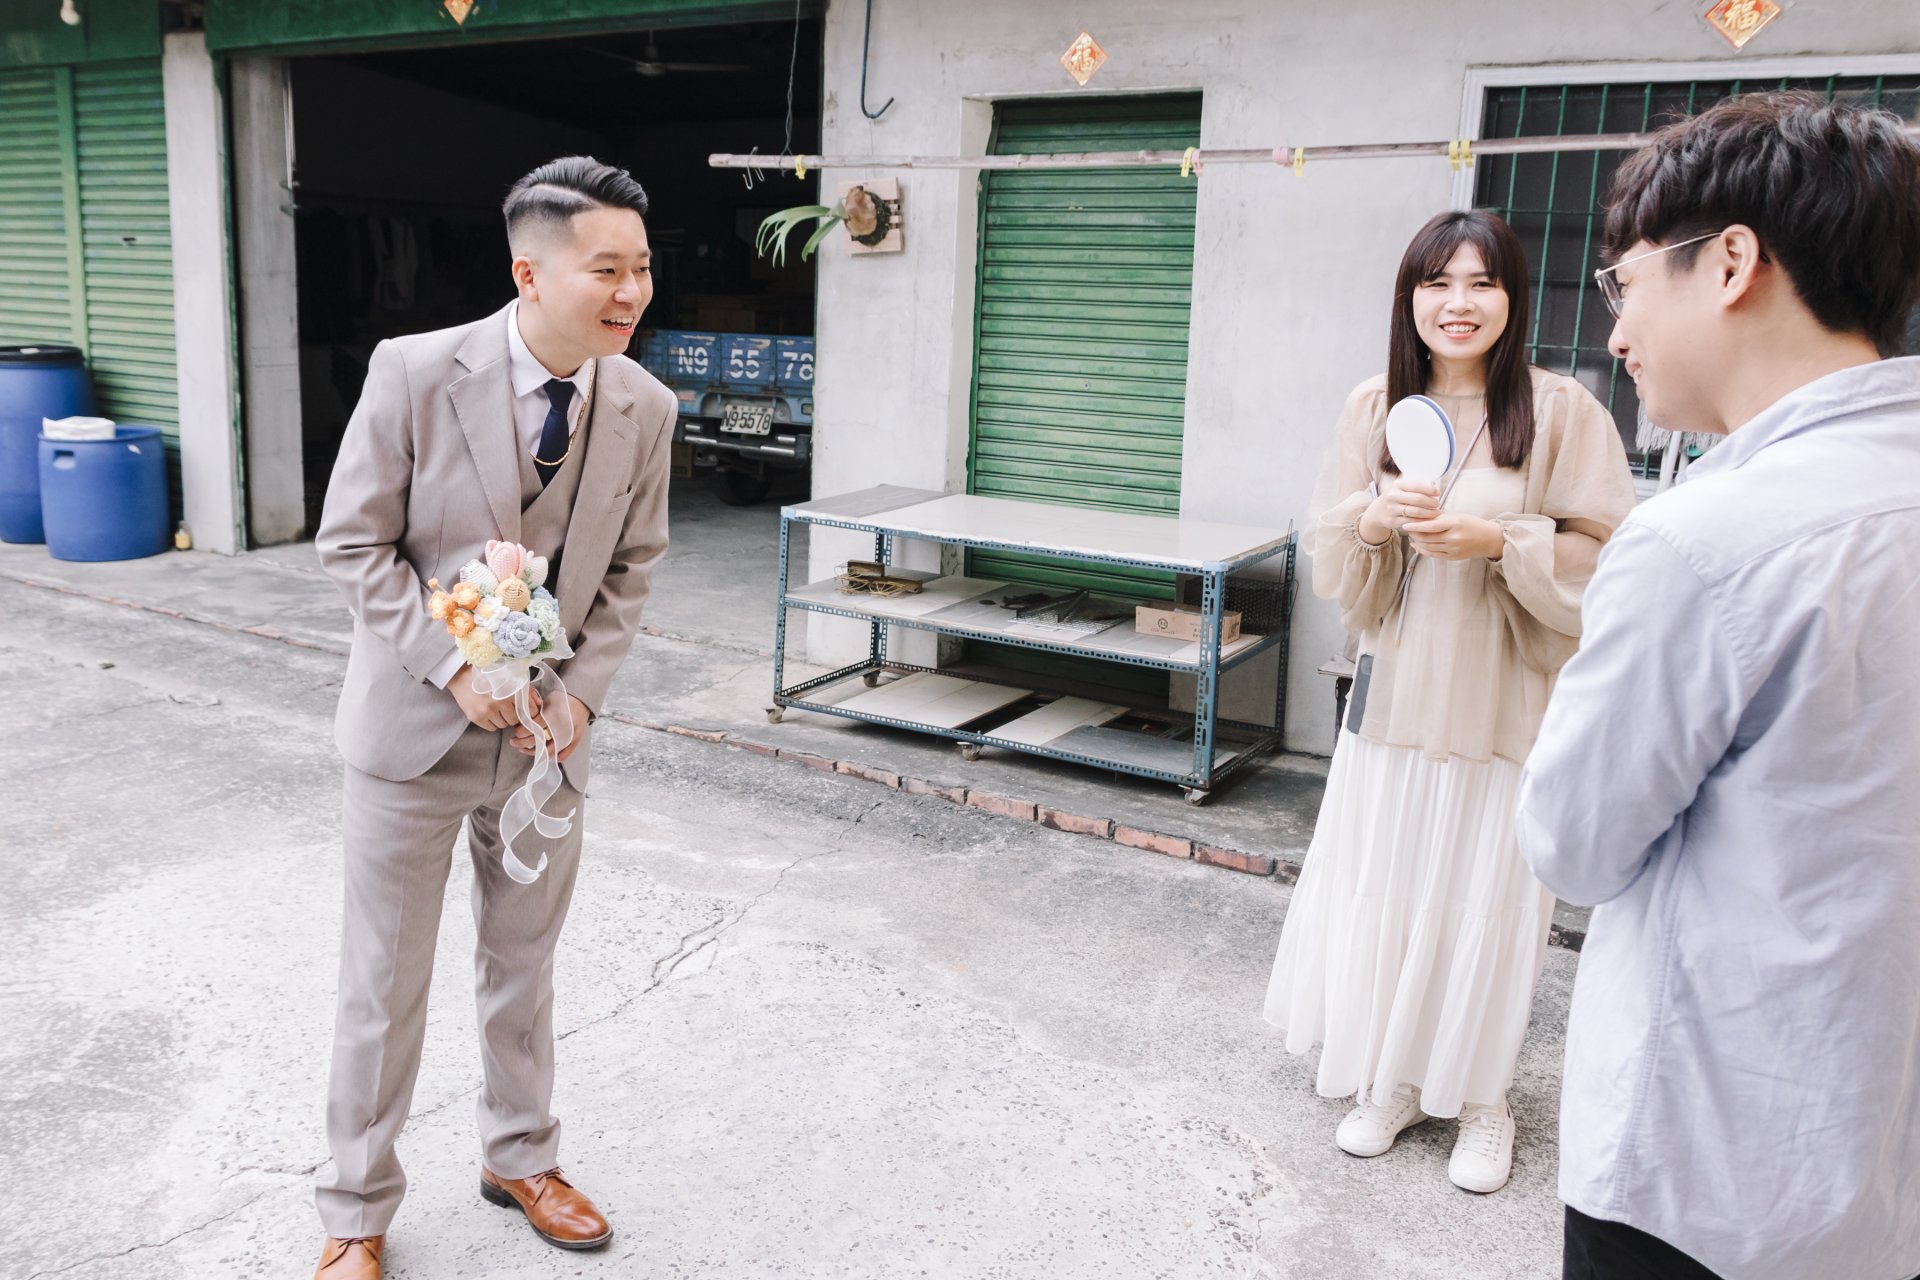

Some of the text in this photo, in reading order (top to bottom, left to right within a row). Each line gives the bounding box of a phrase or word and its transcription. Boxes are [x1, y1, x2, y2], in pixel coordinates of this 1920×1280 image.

[678, 346, 814, 381] N9 55 78
